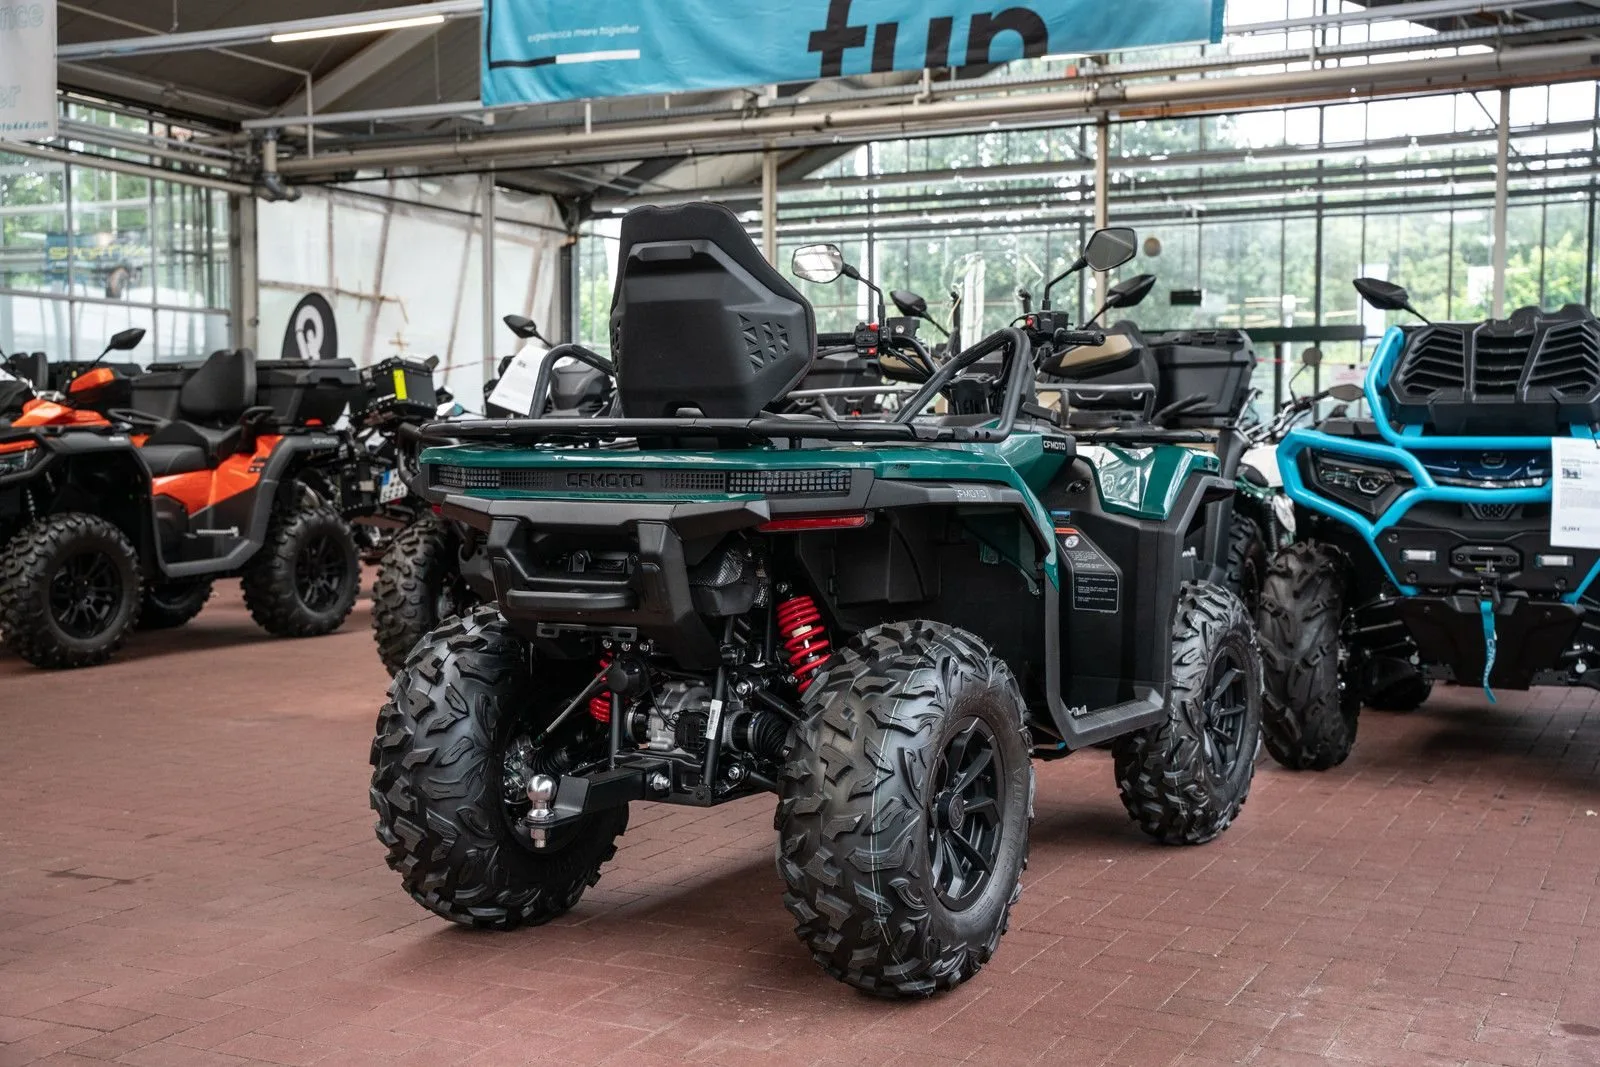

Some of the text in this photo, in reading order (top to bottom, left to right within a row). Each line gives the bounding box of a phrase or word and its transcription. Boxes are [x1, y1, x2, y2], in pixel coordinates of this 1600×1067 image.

[599, 25, 640, 37] together
[1043, 439, 1067, 451] CFMOTO
[565, 472, 644, 489] CFMOTO
